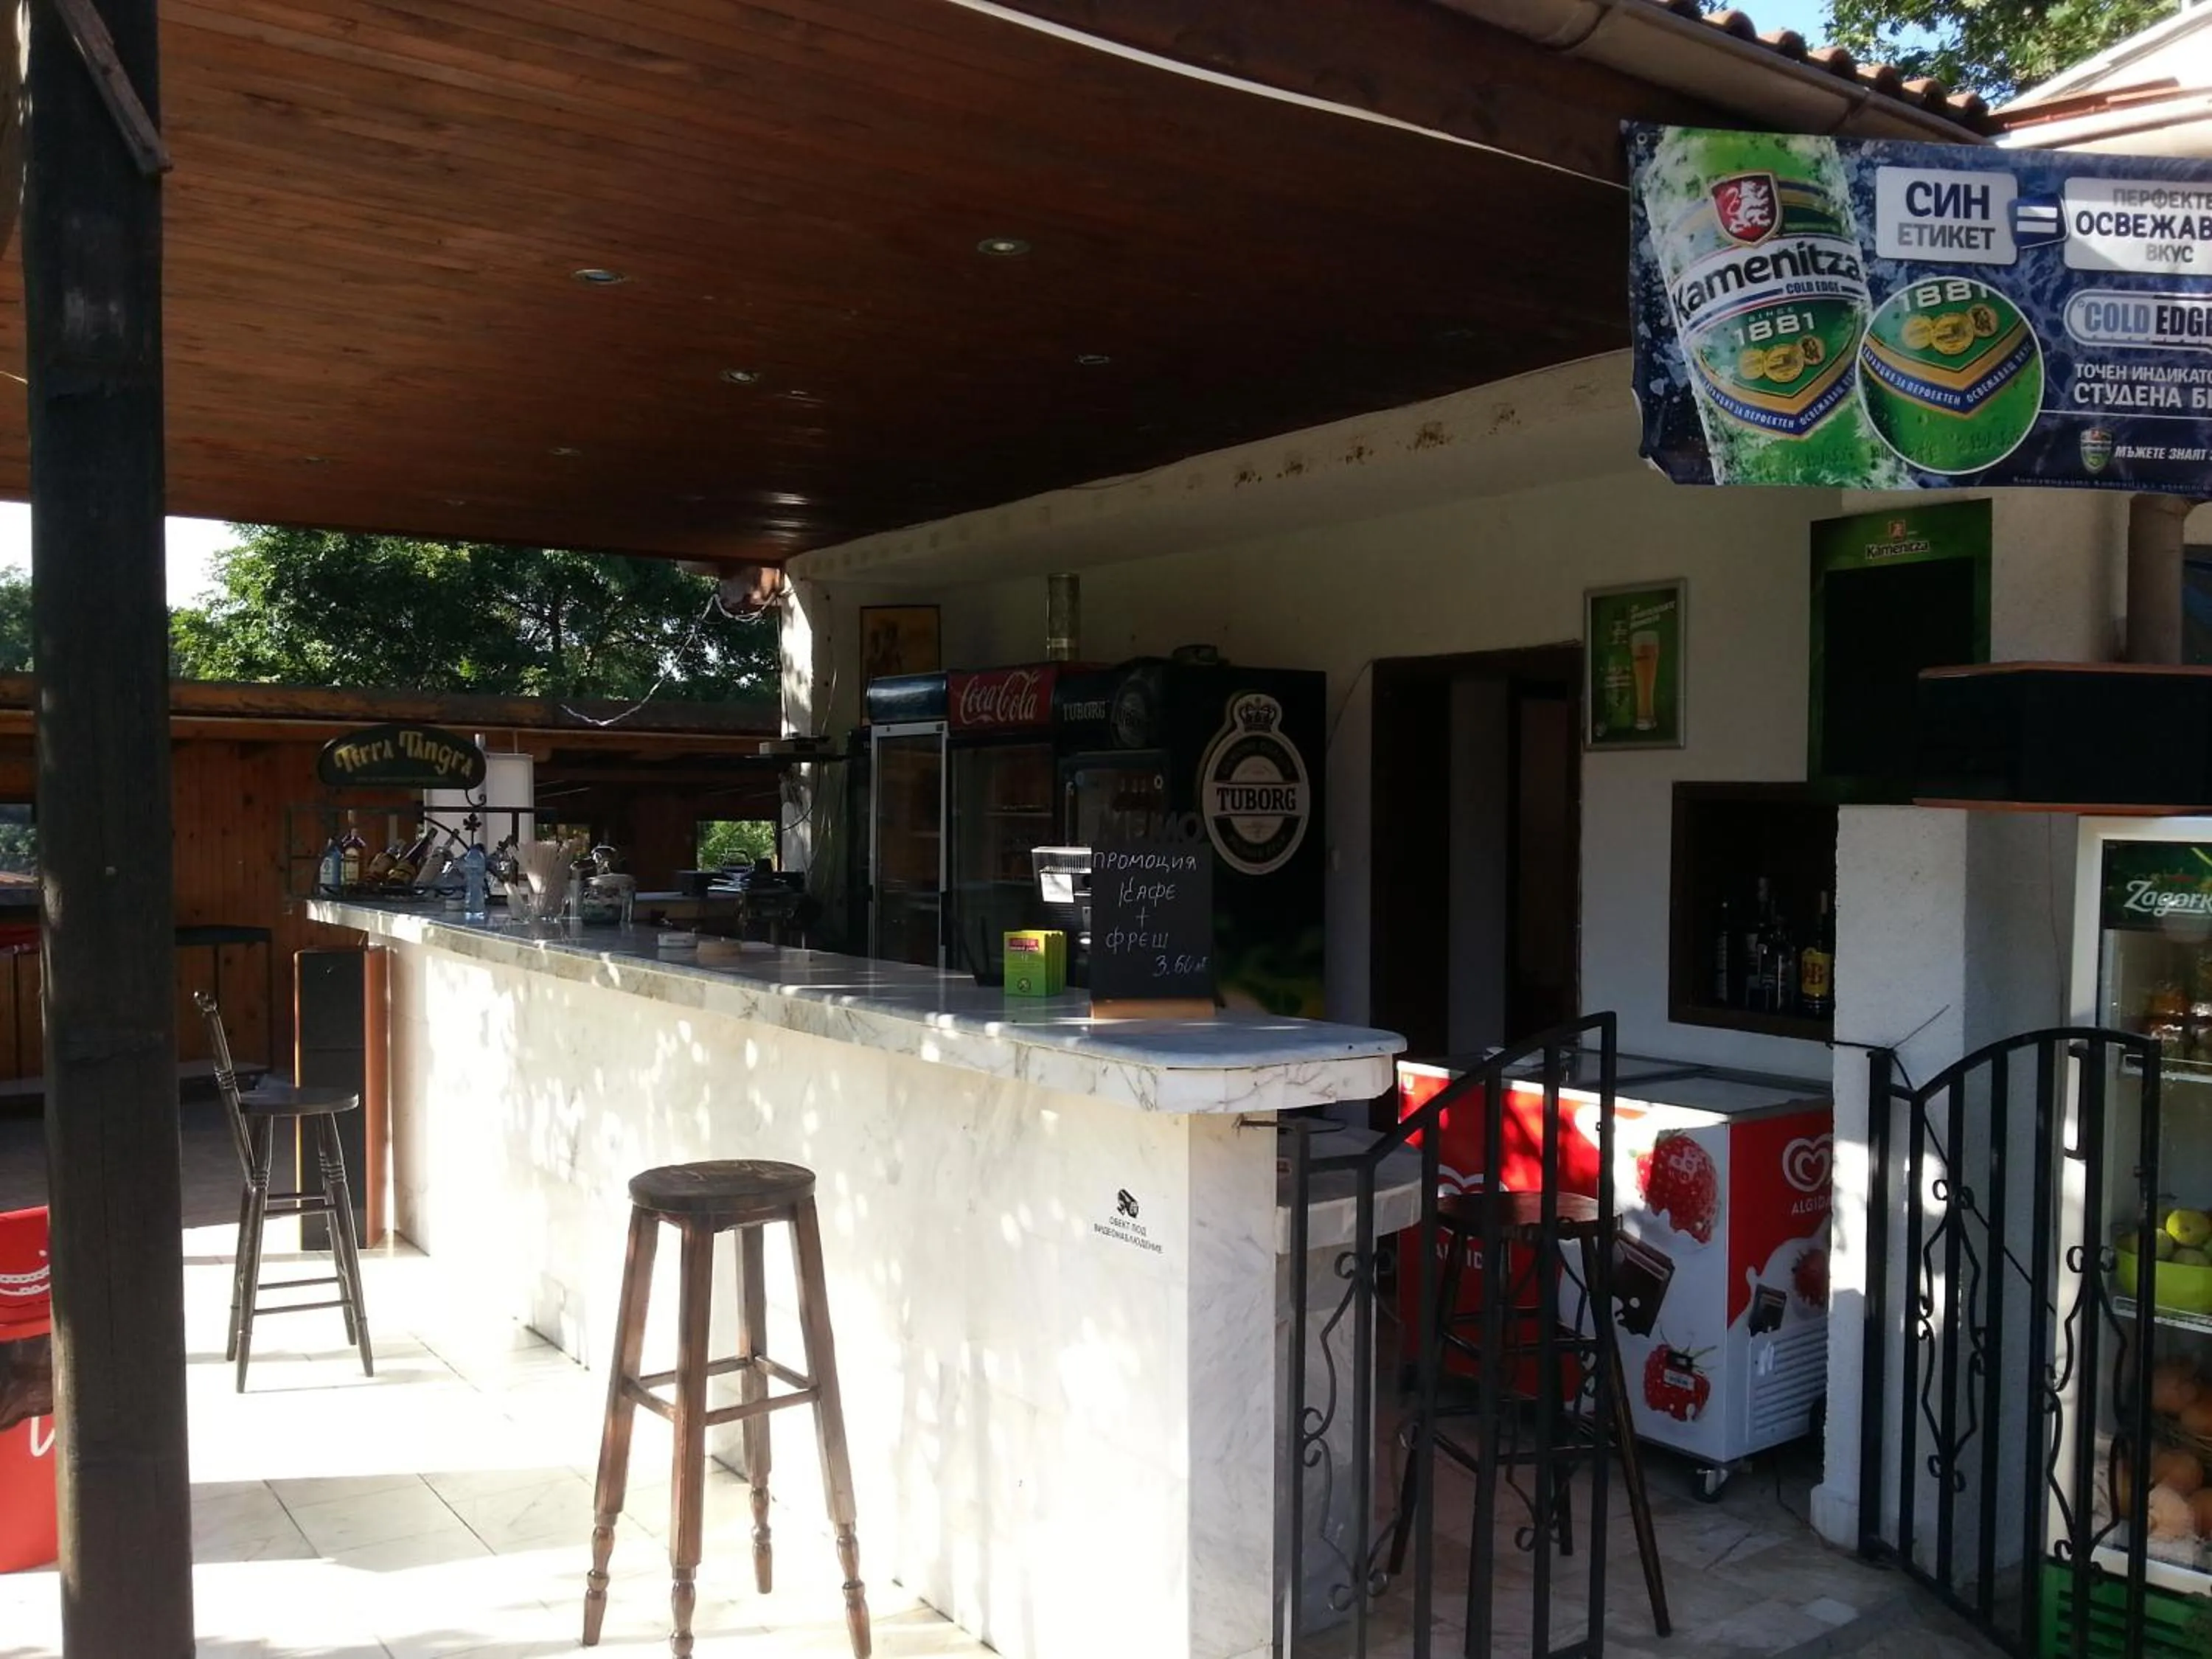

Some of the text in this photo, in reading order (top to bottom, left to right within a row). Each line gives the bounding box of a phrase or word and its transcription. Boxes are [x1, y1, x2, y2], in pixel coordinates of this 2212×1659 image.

[1905, 181, 1990, 220] СИН
[1897, 222, 1996, 250] ЕТИКЕТ
[2076, 209, 2212, 241] ОСВЕЖАВ
[2146, 243, 2194, 263] ВКУС
[1671, 240, 1864, 323] Kamenitza
[1786, 280, 1840, 294] COLD EDGE
[1733, 310, 1816, 346] 1881
[2084, 301, 2151, 334] COLD
[2074, 364, 2128, 380] ТОЧЕН
[2073, 381, 2183, 409] СТУДЕНА
[2114, 445, 2166, 459] МЪЖЕТЕ
[2167, 446, 2208, 462] ЗНАЯТ
[959, 669, 1040, 726] Coca-Cola
[1062, 700, 1106, 722] TUBORG
[1216, 787, 1297, 811] TUBORG
[1092, 851, 1197, 874] ПРОМОЦИЯ
[1105, 925, 1169, 956] ФРЕШ
